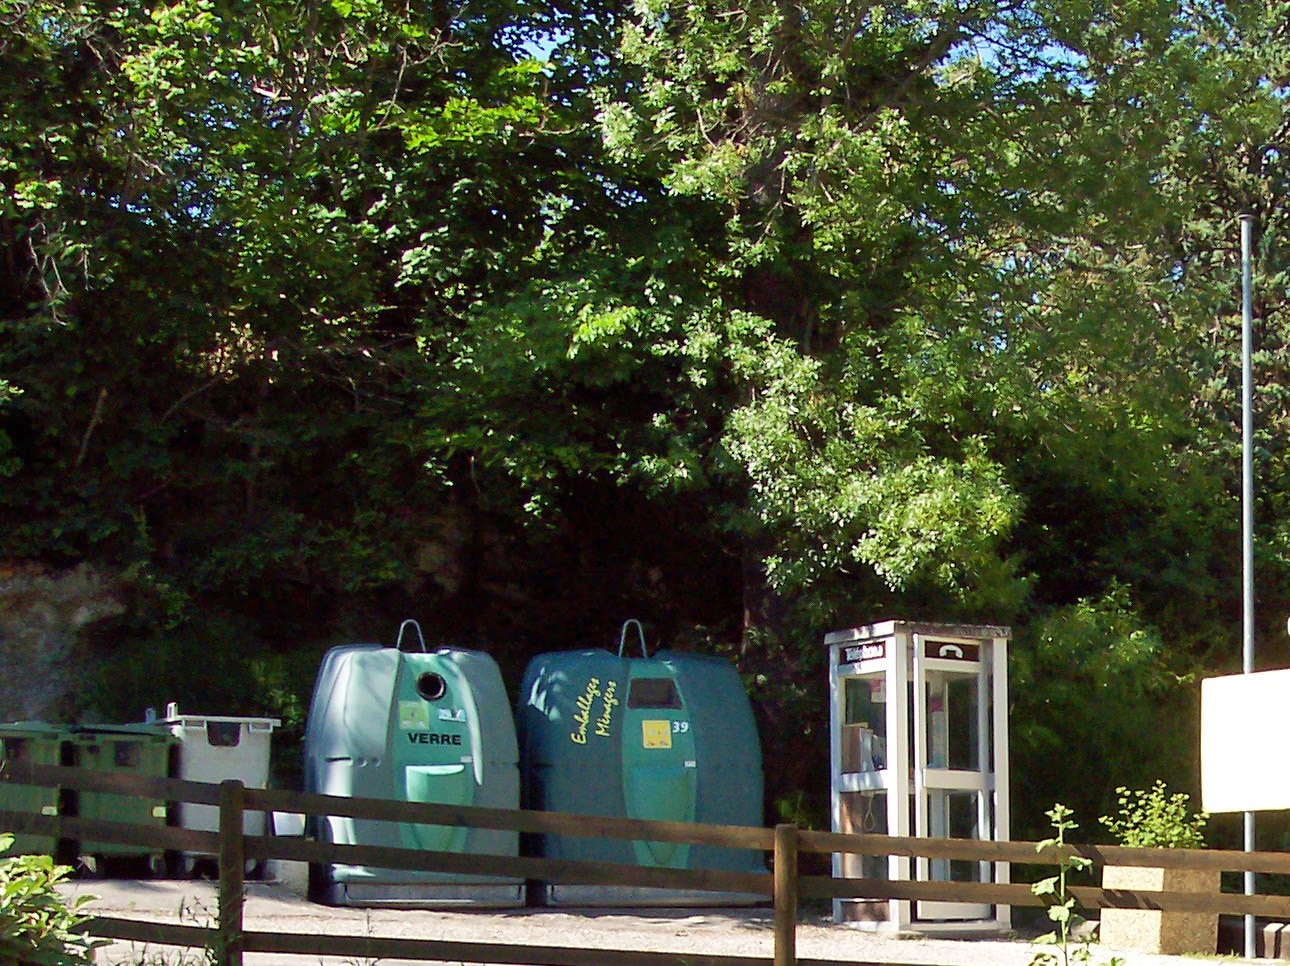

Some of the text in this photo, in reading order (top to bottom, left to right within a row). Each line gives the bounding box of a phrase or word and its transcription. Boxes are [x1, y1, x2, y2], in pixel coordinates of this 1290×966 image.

[571, 677, 601, 744] Emballages
[672, 721, 689, 734] 39
[408, 732, 462, 746] VERRE
